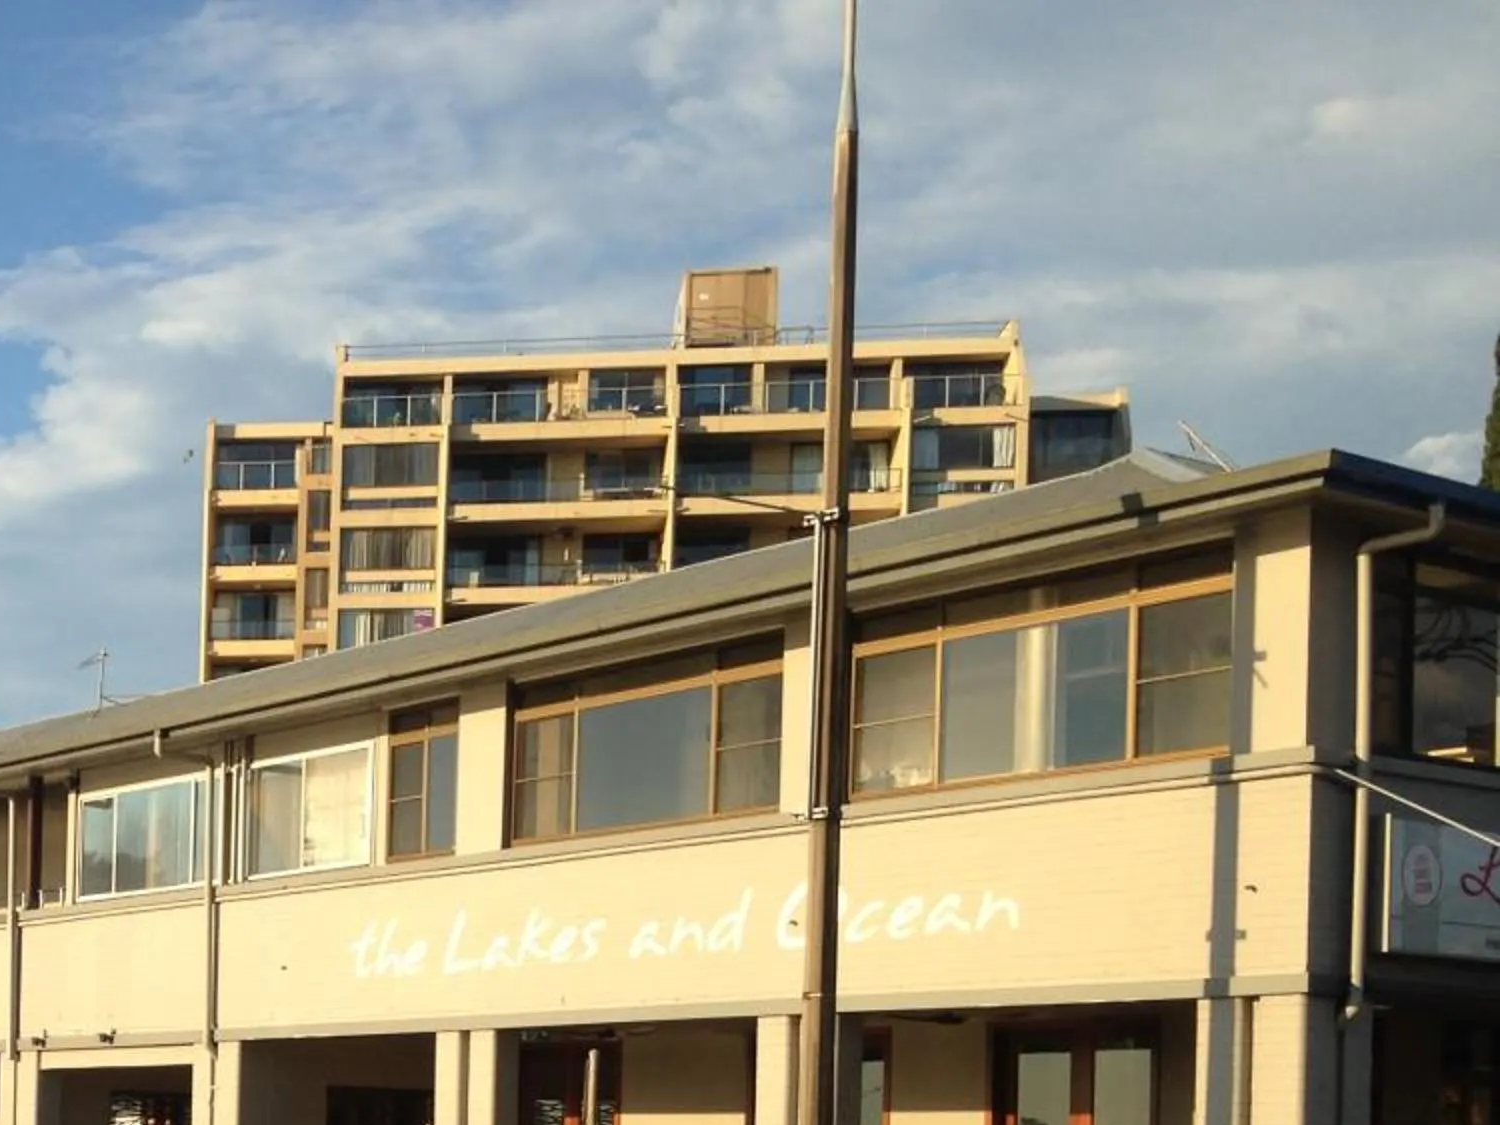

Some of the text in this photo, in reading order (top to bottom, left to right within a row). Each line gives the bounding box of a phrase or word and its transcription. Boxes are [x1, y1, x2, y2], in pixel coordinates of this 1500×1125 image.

[348, 916, 428, 978] the
[443, 907, 607, 974] Lakes
[628, 886, 753, 960] and
